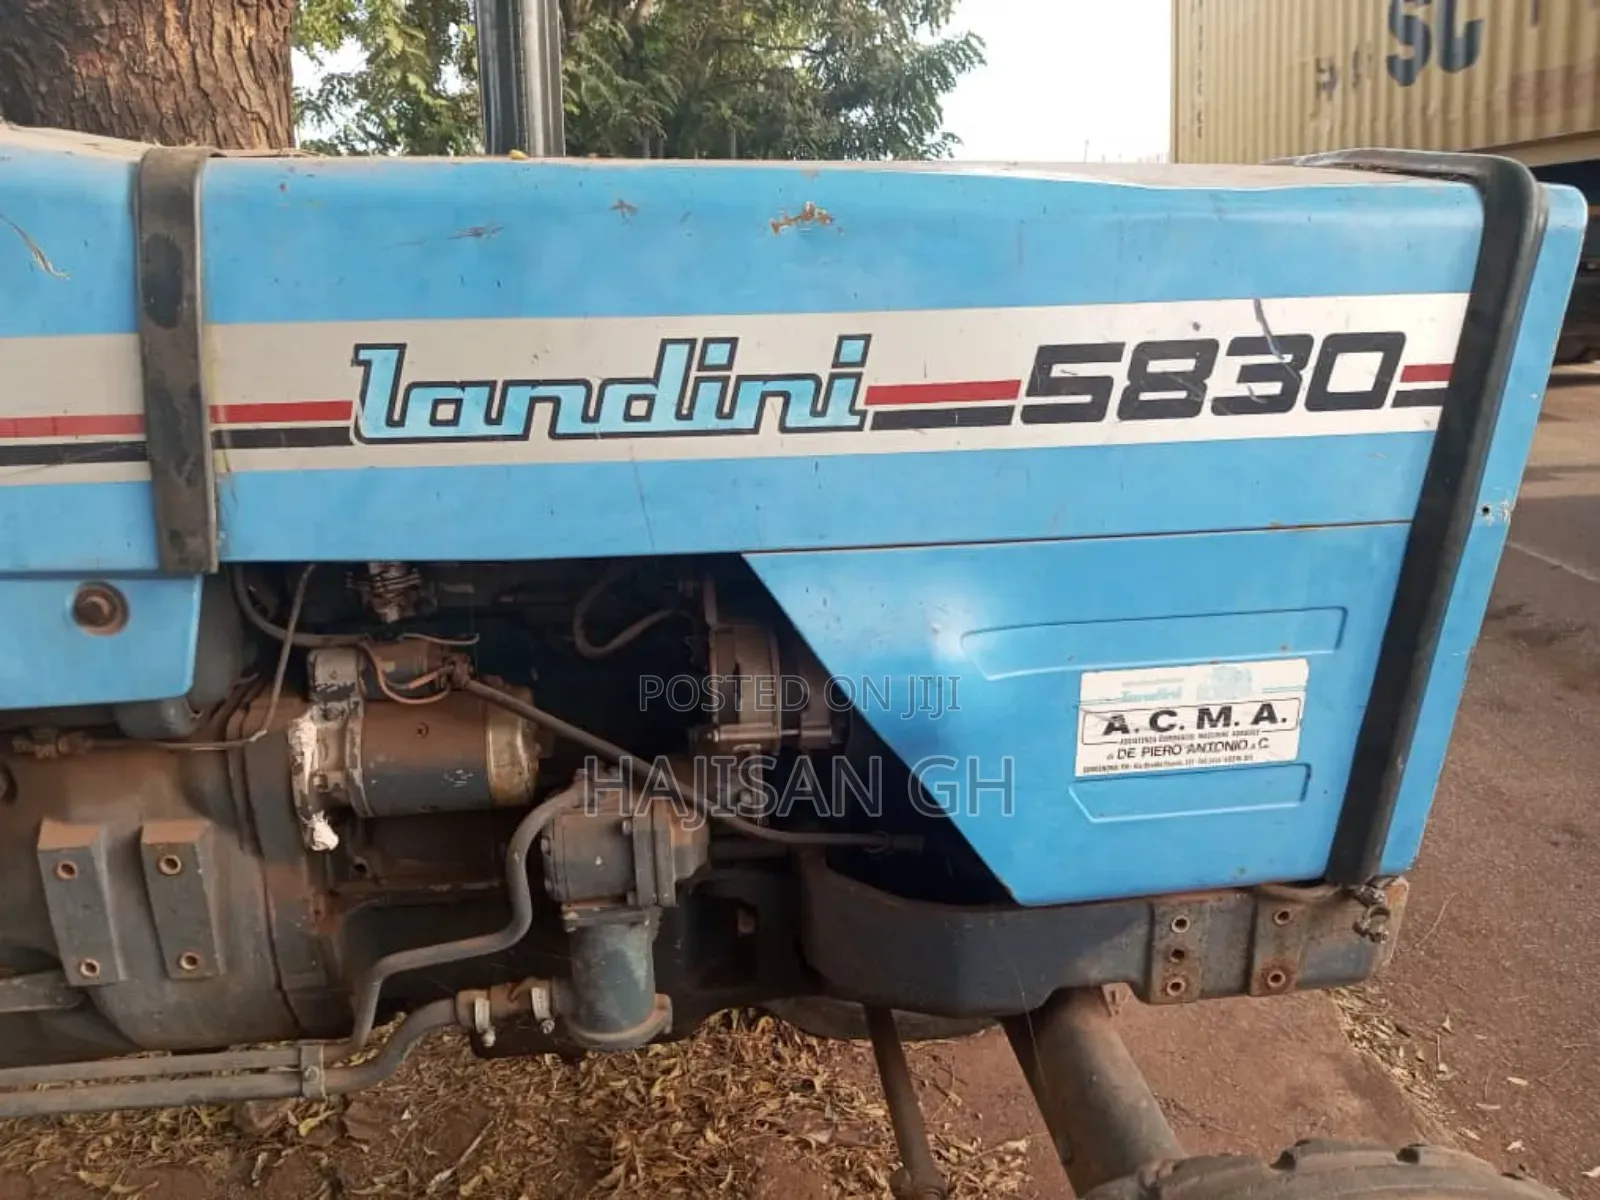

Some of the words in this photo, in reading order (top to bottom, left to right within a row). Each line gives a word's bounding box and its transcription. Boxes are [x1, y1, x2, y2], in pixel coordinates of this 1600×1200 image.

[352, 333, 871, 444] landini
[1020, 331, 1406, 424] 5830
[1117, 747, 1136, 760] DE
[1141, 744, 1182, 758] PIERO
[1187, 740, 1248, 754] ANTONIO
